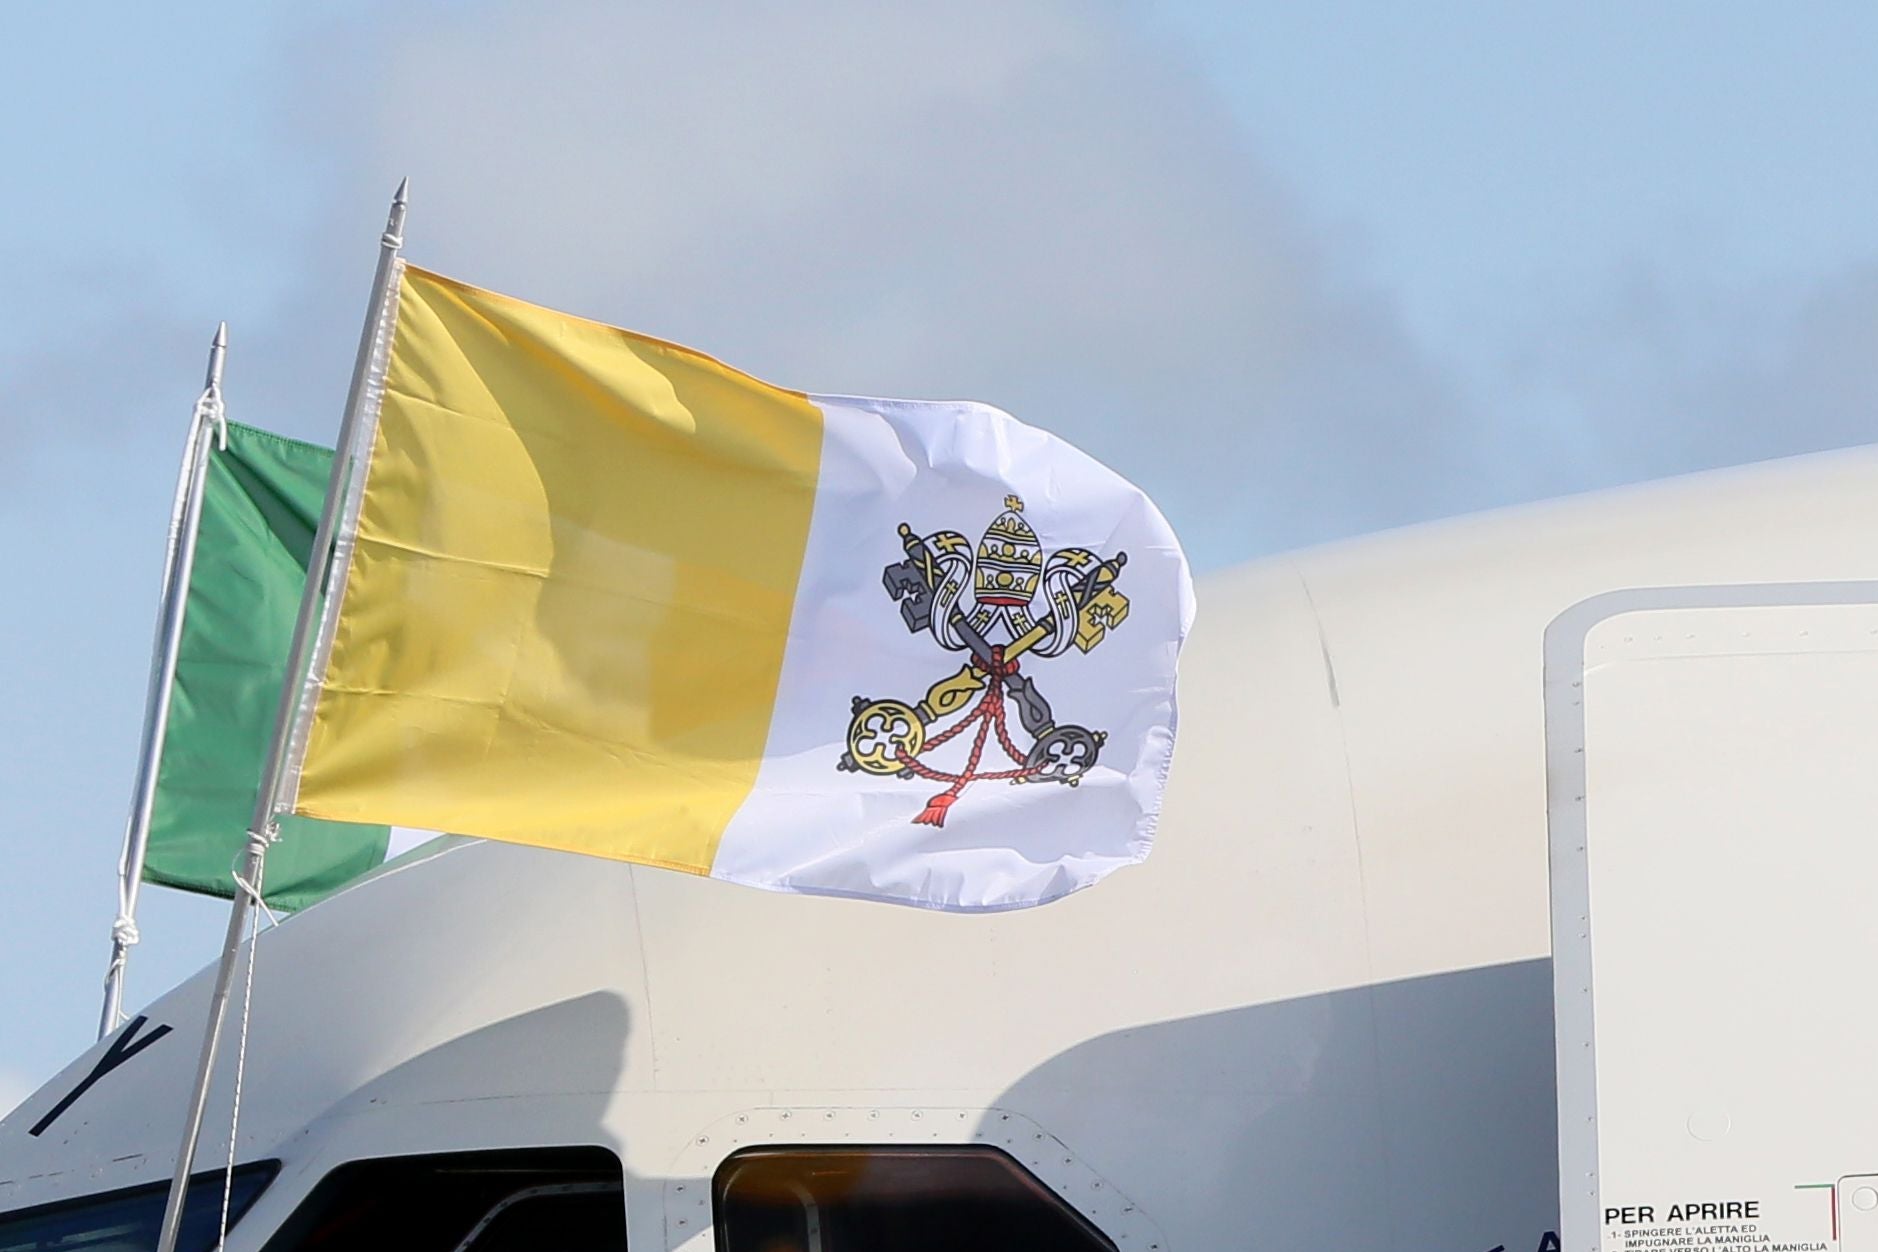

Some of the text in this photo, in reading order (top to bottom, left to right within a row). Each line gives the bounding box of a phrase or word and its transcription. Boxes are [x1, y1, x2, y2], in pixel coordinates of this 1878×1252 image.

[1605, 1200, 1760, 1225] PER APRIRE
[1624, 1227, 1682, 1239] SPINGERE
[1685, 1225, 1739, 1236] L'ALETTA
[1741, 1224, 1757, 1233] ED
[1625, 1234, 1770, 1248] IMPUGNARE LA MANIGLIA
[1754, 1244, 1769, 1252] LA
[1771, 1242, 1828, 1252] MANIGLIA
